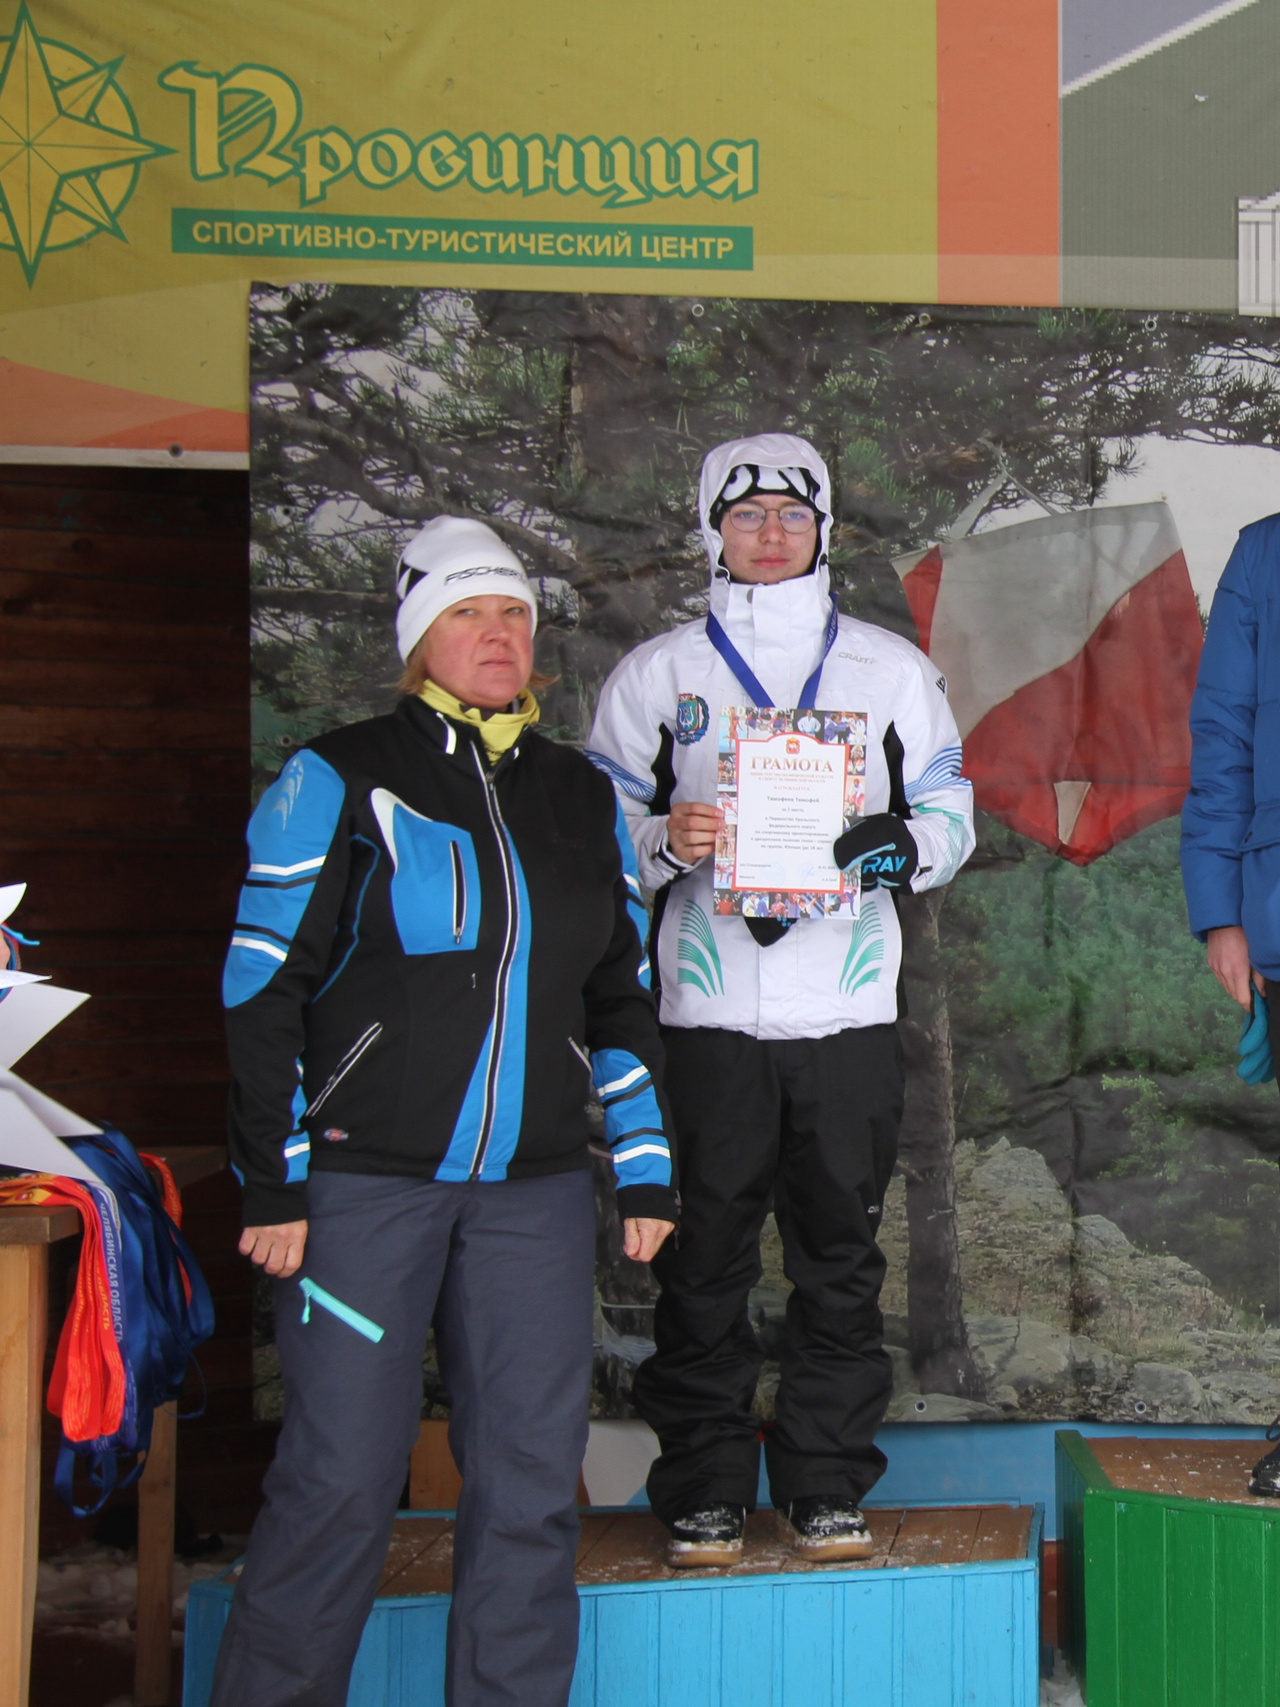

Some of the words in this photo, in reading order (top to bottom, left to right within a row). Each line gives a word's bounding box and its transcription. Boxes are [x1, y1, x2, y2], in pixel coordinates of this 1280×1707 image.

[157, 60, 759, 209] Провинция
[192, 220, 632, 259] СПОРТИВНО-ТУРИСТИЧЕСКИЙ
[641, 235, 734, 262] ЦЕНТР
[751, 756, 834, 772] ГРАМОТА
[862, 855, 907, 875] RAY
[100, 1202, 119, 1288] ЧЕЛЯБИНСКАЯ
[110, 1289, 123, 1344] ОБЛАСТЬ
